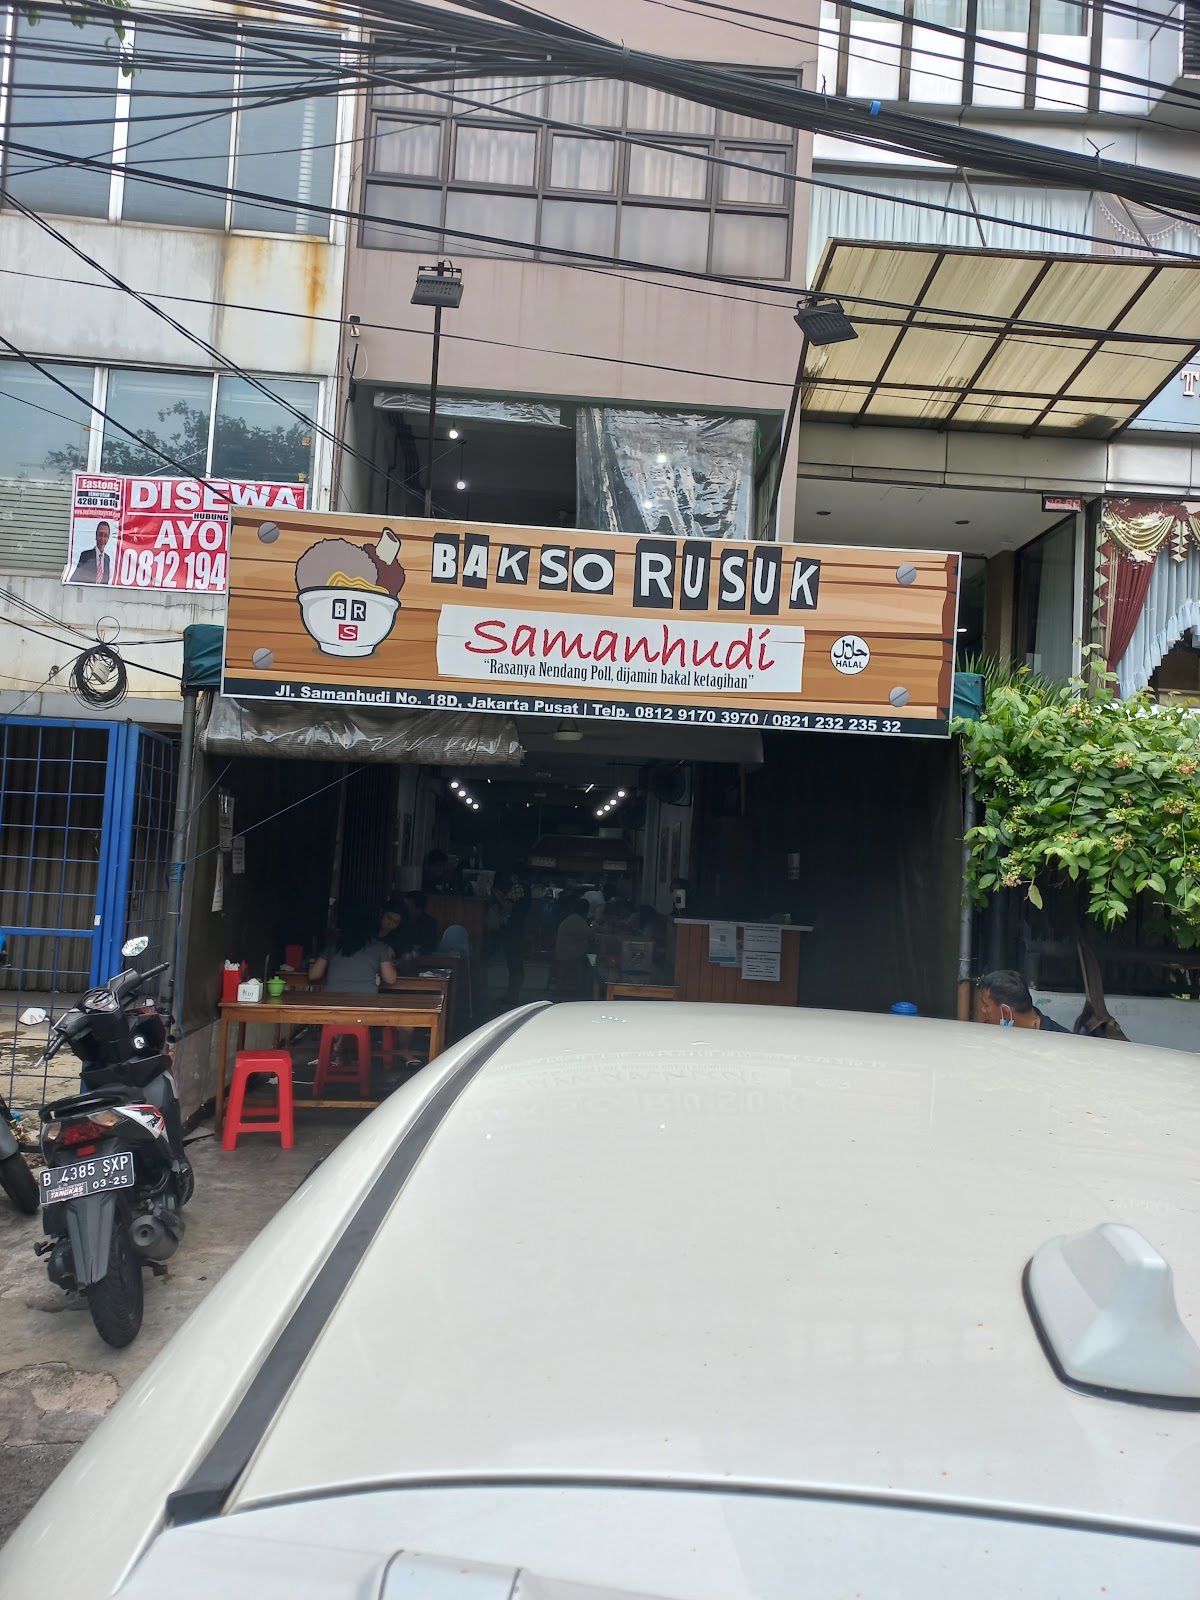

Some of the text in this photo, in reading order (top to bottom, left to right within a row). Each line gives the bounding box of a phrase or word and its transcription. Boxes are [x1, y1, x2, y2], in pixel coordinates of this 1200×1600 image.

[82, 479, 120, 491] Eastons
[130, 480, 299, 512] DISEWA
[77, 498, 97, 506] 4280
[154, 520, 228, 551] AYO
[120, 549, 226, 590] 0812 194
[432, 542, 819, 606] BAKSO RUSUK
[340, 626, 357, 640] S
[464, 620, 775, 671] Samanhudi
[538, 661, 587, 681] Nendang
[591, 665, 614, 682] Poll,
[616, 667, 658, 684] dijamin
[660, 669, 691, 686] bakal
[836, 660, 864, 669] HALAL
[275, 684, 295, 697] Jl.
[300, 686, 390, 703] Samanhudi
[396, 691, 422, 705] No.
[427, 693, 463, 708] 18D,
[467, 696, 529, 712] Jakarta
[534, 700, 579, 715] Pusat
[592, 703, 630, 718] Telp.
[634, 706, 674, 720] 0812
[678, 708, 717, 723] 9170
[721, 711, 759, 725] 3970
[772, 714, 810, 728] 0821
[815, 716, 844, 730] 232
[848, 718, 878, 732] 235
[881, 720, 902, 733] 32
[42, 1155, 129, 1187] B 4385 SXP
[50, 1185, 84, 1199] TANGKAS
